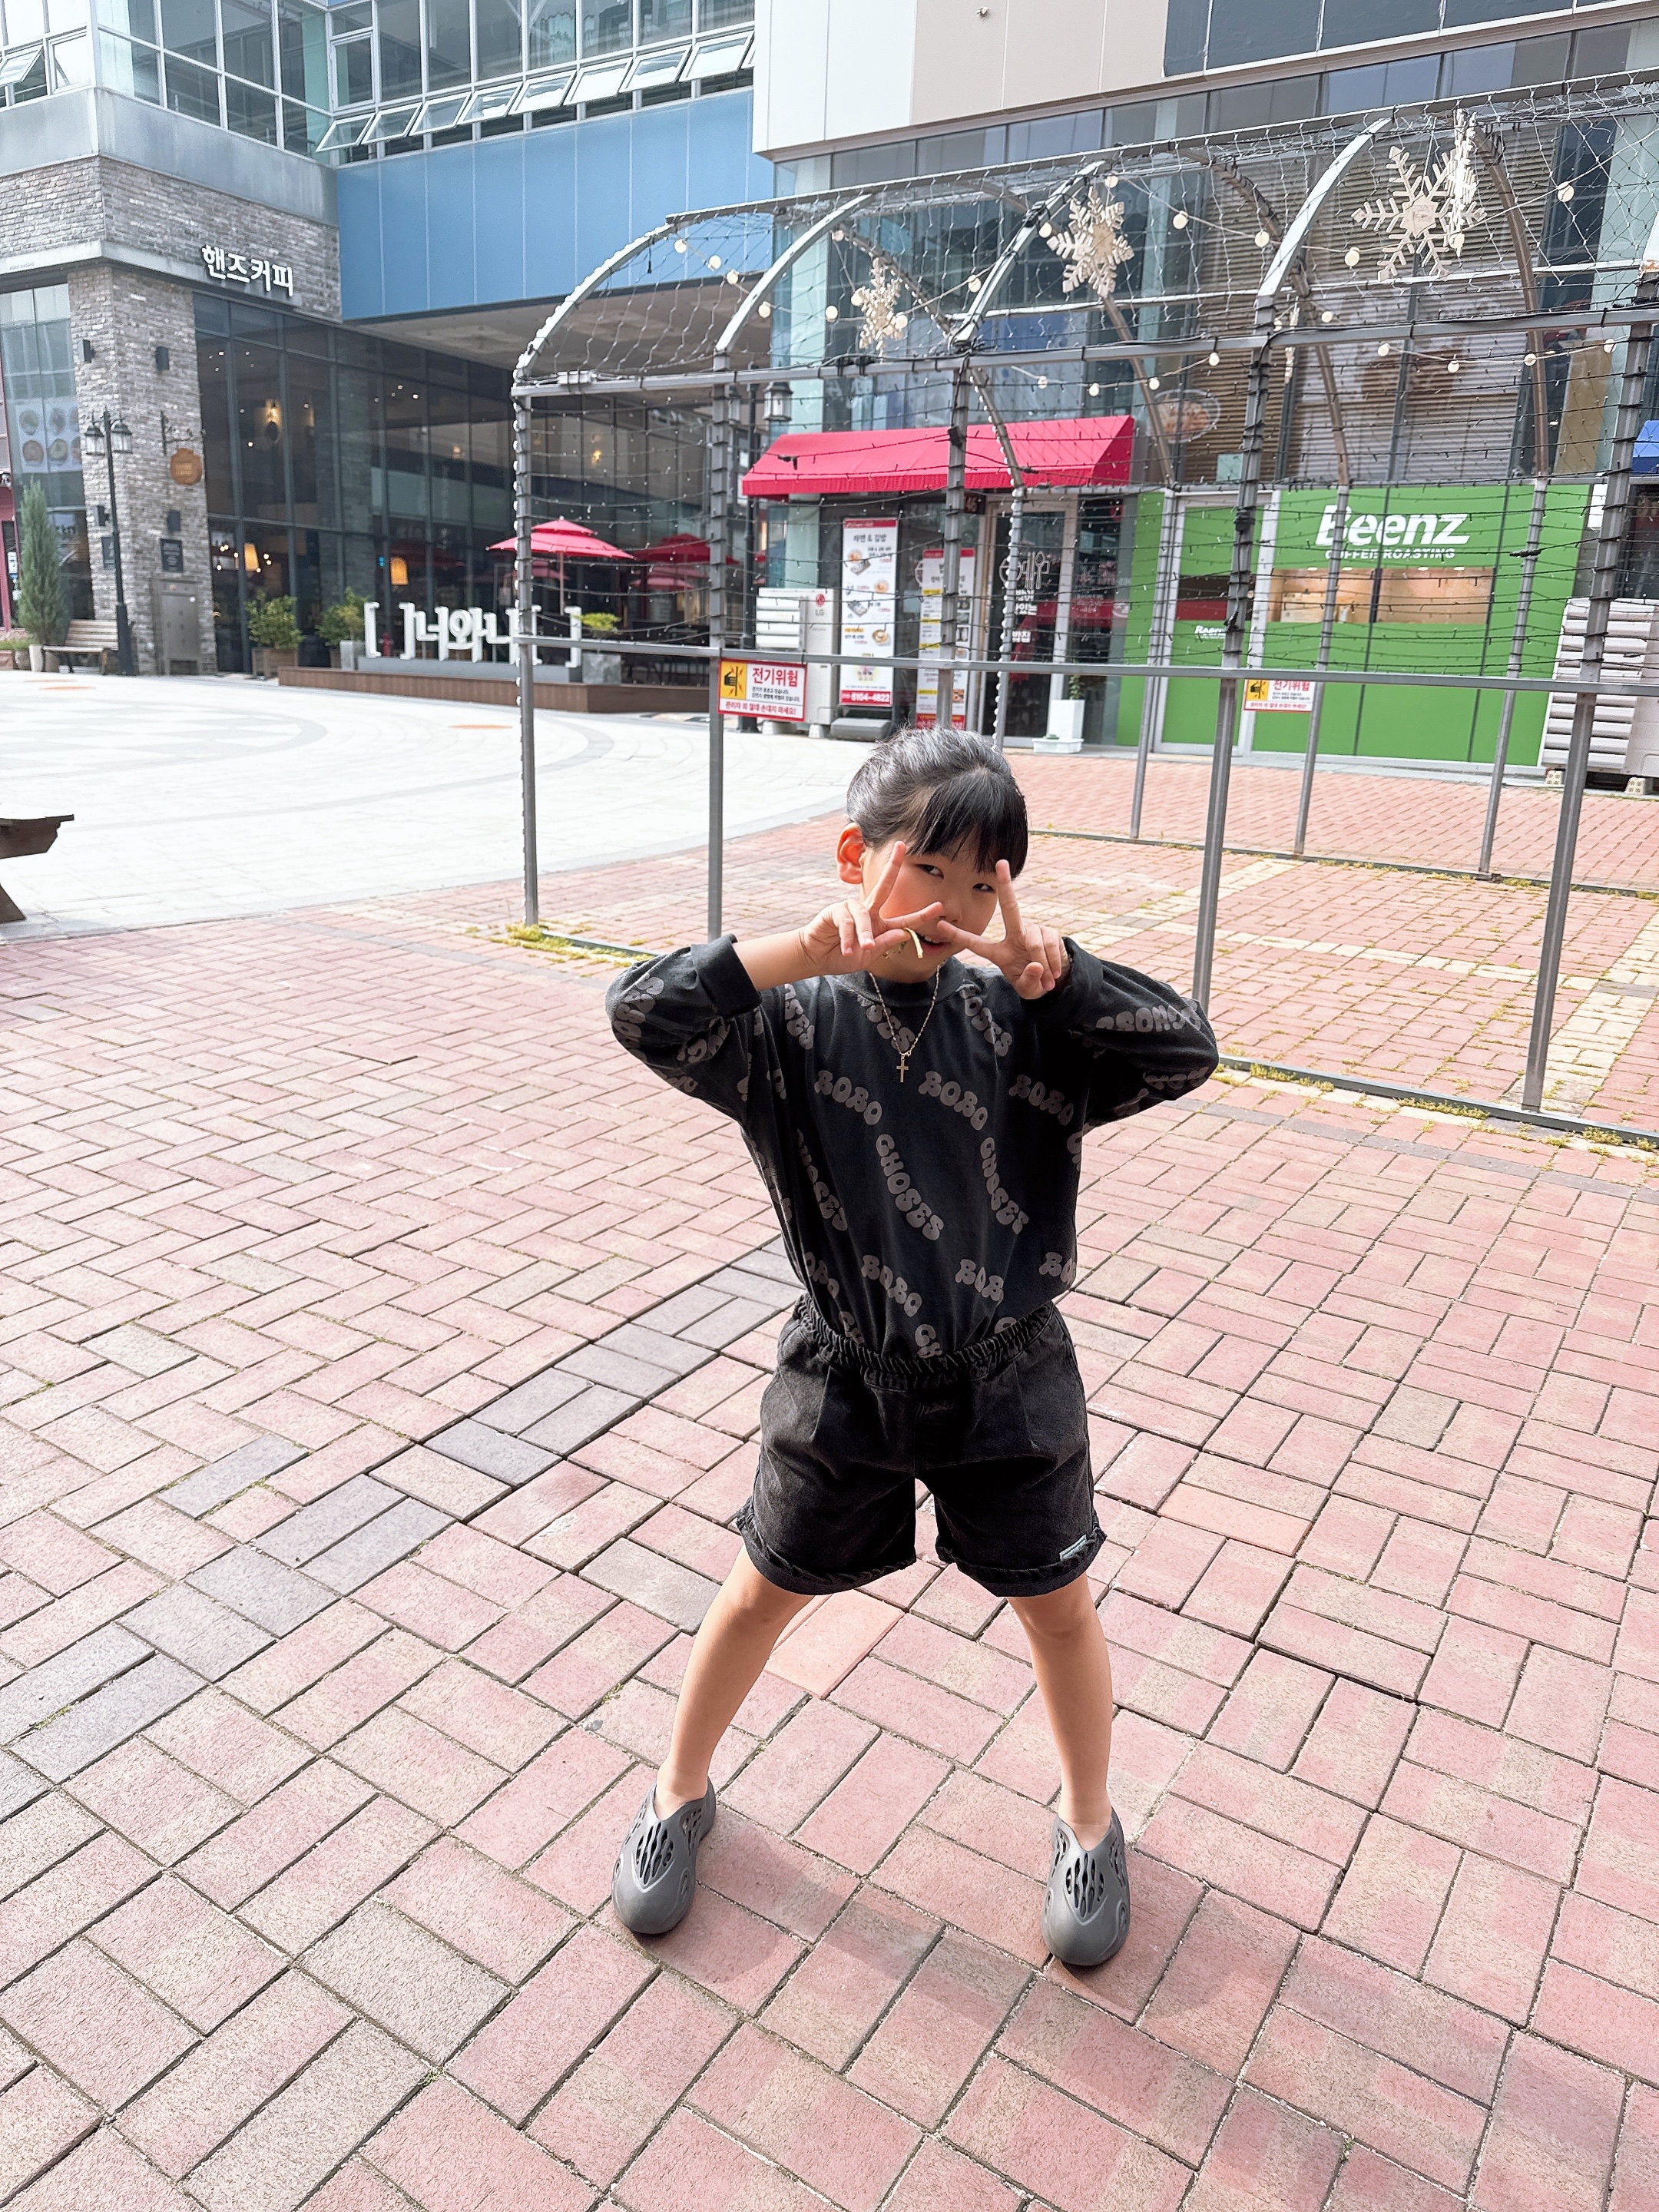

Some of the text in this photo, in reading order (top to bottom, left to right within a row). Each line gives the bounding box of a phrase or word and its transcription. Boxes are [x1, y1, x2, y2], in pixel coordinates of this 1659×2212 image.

[201, 244, 293, 297] 핸즈커피
[1315, 504, 1470, 546] Beenz
[1383, 548, 1455, 560] ROASTING
[752, 667, 798, 687] 전기위험
[814, 1070, 882, 1125] BOBO
[918, 1071, 988, 1130] BOBO
[1008, 1075, 1074, 1126] BOBO
[876, 1134, 944, 1240] CHOSES
[980, 1137, 1029, 1234] CHOSES
[862, 1254, 922, 1317] BOBO
